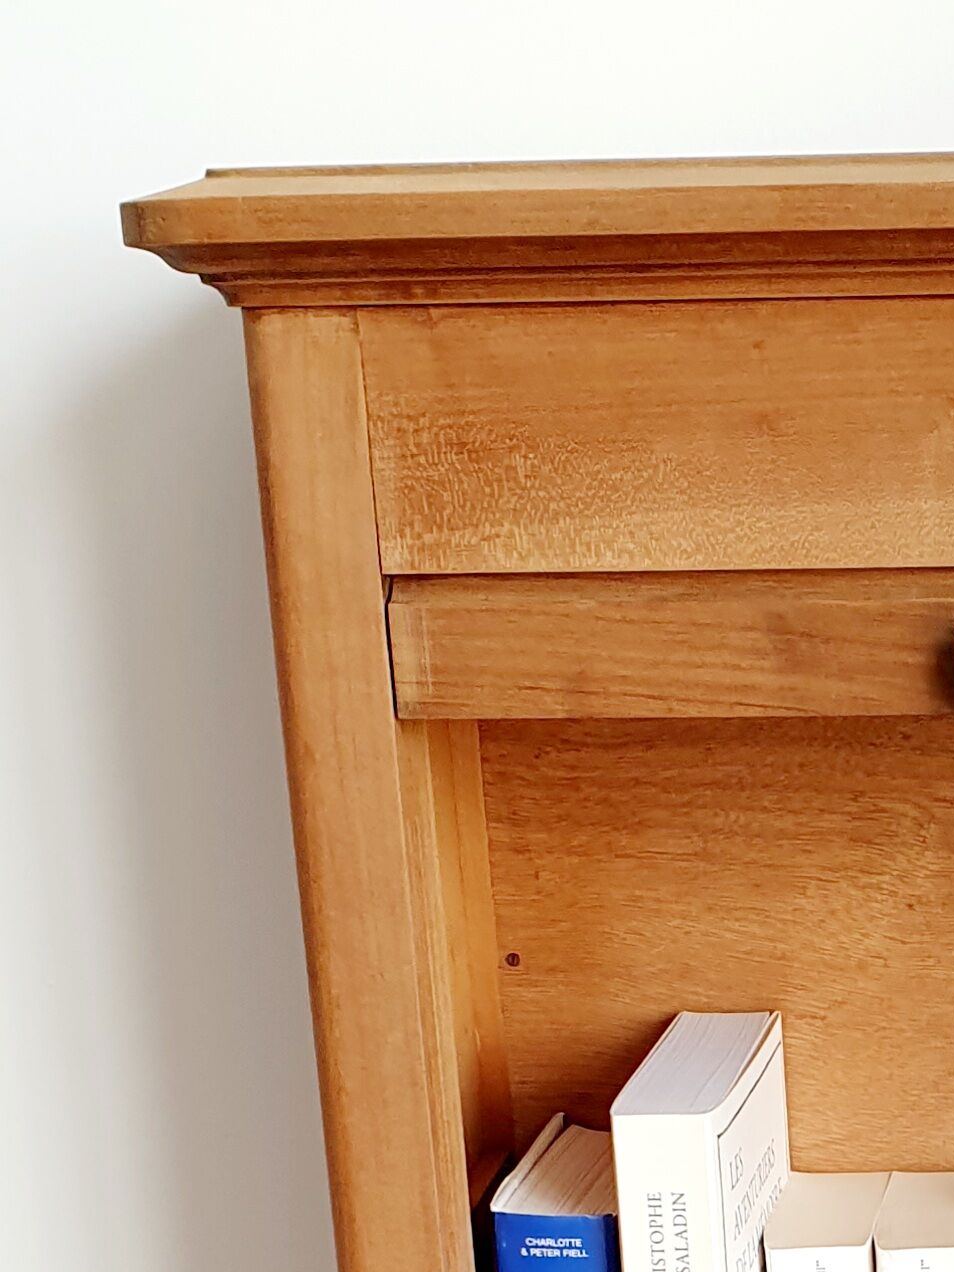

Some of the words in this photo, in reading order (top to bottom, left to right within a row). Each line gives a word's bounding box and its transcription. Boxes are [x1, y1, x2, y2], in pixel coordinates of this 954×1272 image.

[729, 1147, 744, 1191] LES
[525, 1237, 583, 1248] CHARLOTTE
[520, 1247, 529, 1257] &
[530, 1248, 562, 1258] PETER
[562, 1249, 590, 1259] FIELL
